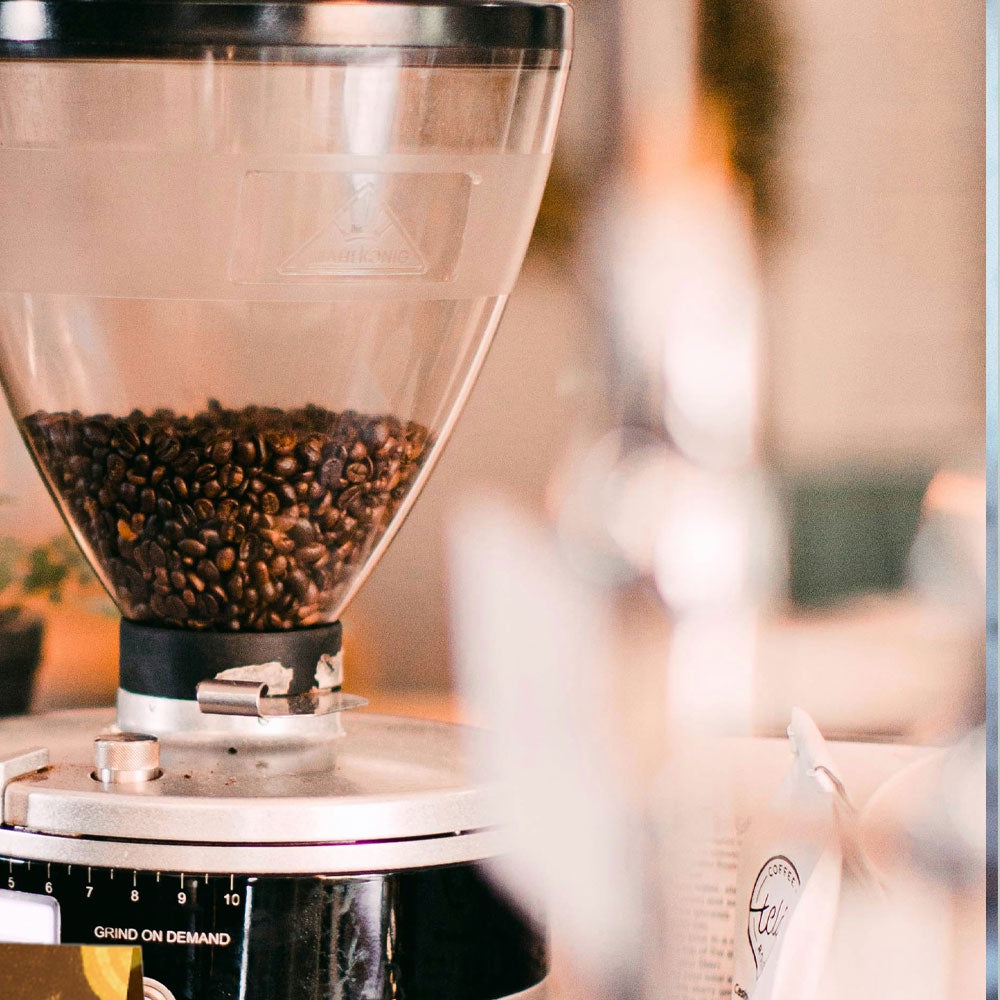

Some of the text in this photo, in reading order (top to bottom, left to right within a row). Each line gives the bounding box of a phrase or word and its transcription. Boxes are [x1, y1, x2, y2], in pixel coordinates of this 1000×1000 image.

[768, 865, 796, 887] COFFEE
[8, 876, 15, 889] 5
[45, 881, 53, 894] 6
[86, 886, 93, 898] 7
[131, 890, 139, 902] 8
[177, 892, 186, 904] 9
[224, 894, 240, 906] 10
[94, 926, 231, 946] GRIND ON DEMAND
